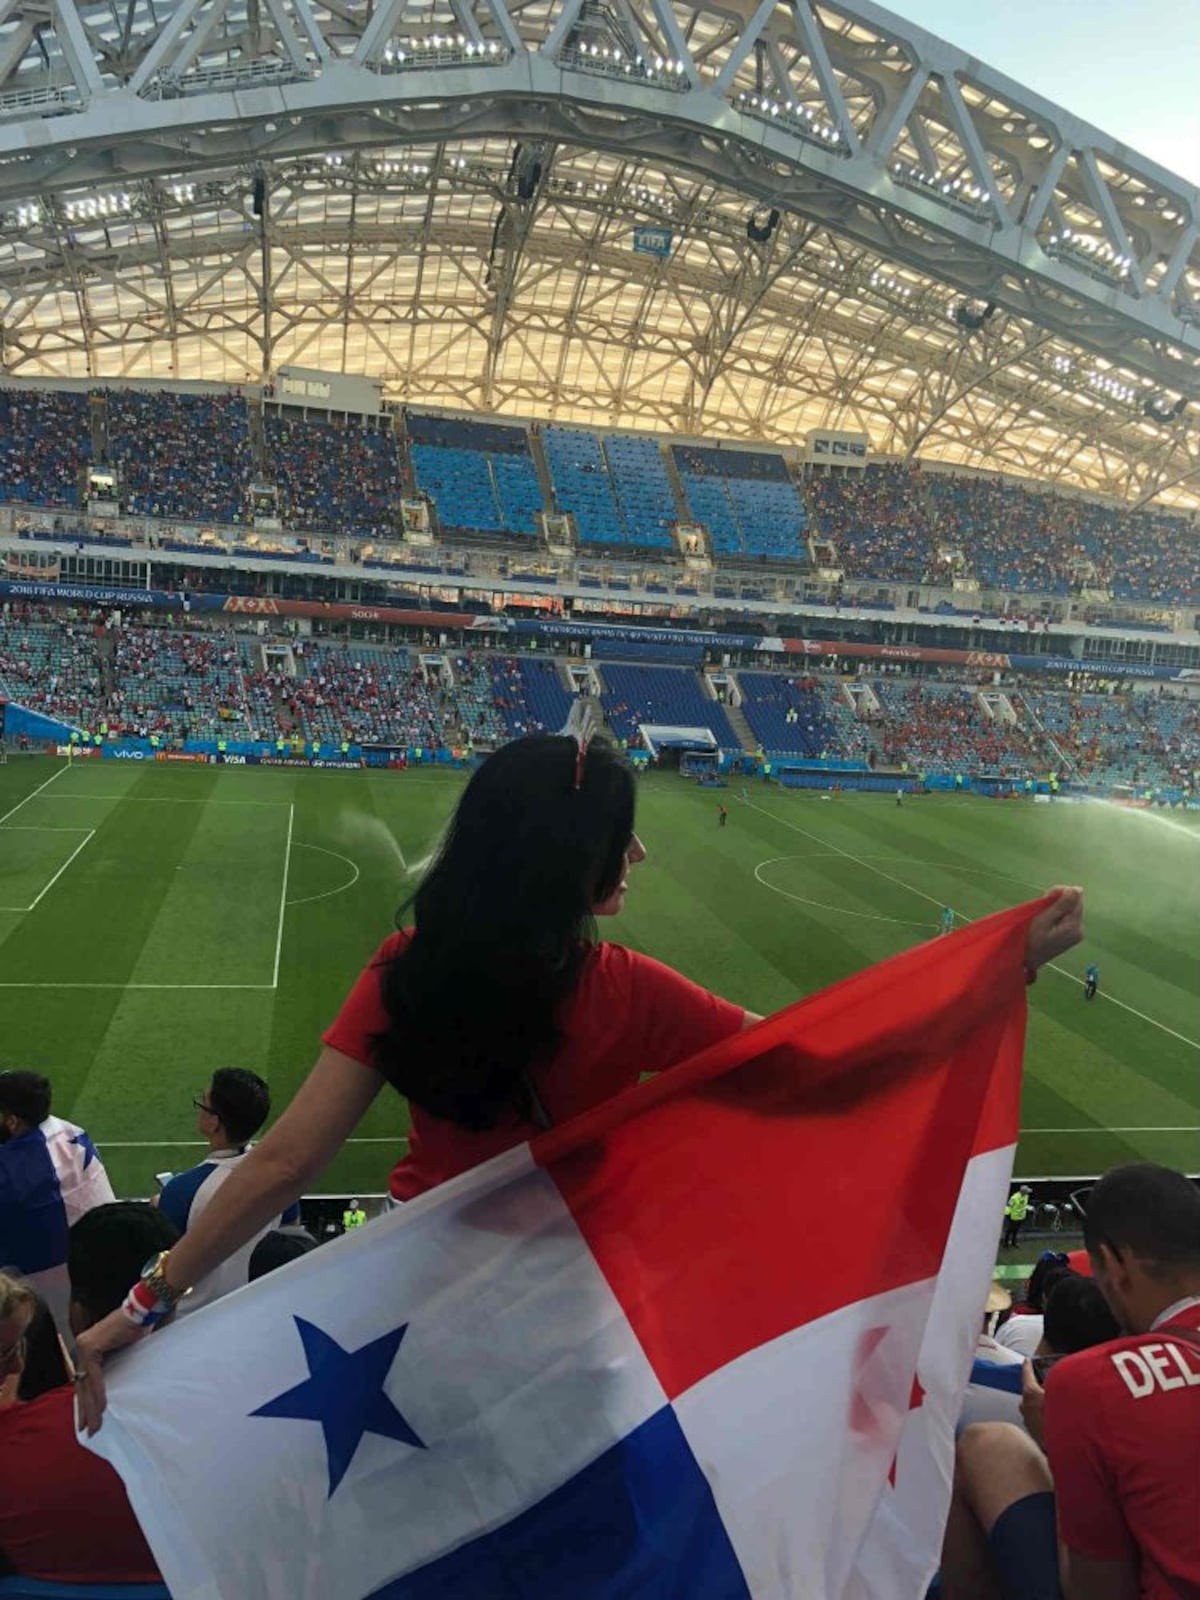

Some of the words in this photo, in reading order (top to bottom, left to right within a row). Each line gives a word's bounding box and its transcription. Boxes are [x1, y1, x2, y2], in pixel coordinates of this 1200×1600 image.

[9, 585, 33, 595] 2018
[34, 586, 55, 596] FIFA
[56, 588, 94, 599] WORLD
[95, 590, 116, 600] CUP
[117, 592, 153, 603] RUSSIA
[223, 754, 246, 765] VISA
[1110, 1343, 1200, 1399] DEL
